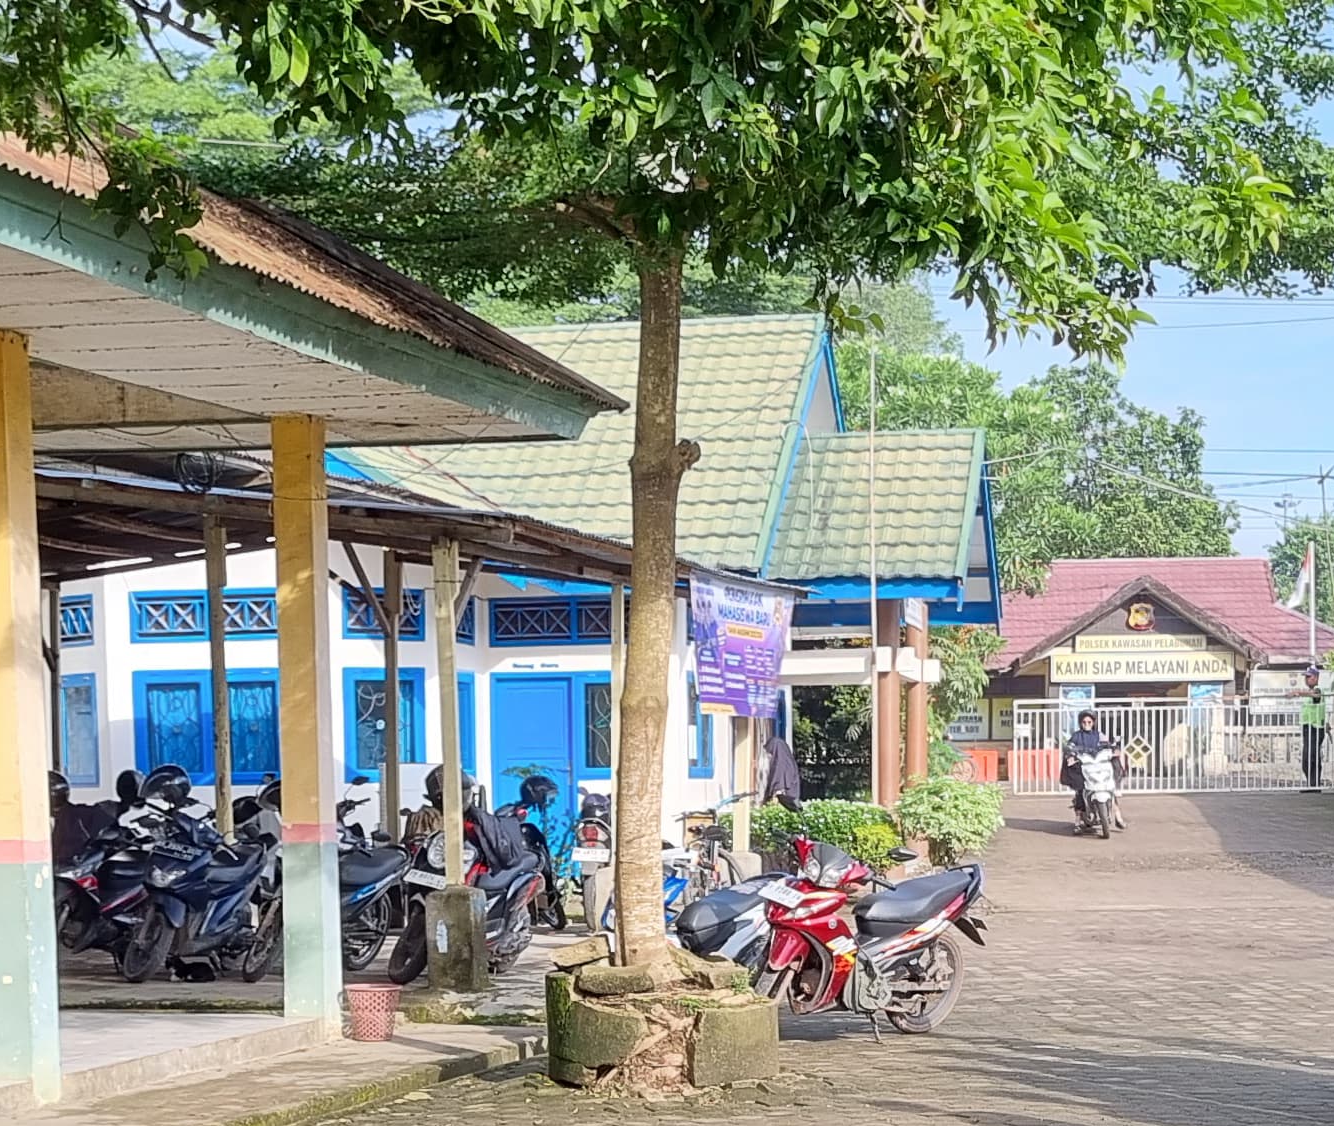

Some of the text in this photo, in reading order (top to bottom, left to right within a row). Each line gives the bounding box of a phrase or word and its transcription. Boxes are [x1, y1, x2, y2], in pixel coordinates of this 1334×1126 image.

[1079, 638, 1203, 649] POLSEK KAWASAN PELABUHAN
[1055, 659, 1228, 676] KAMI SIAP MELAYANI ANDA
